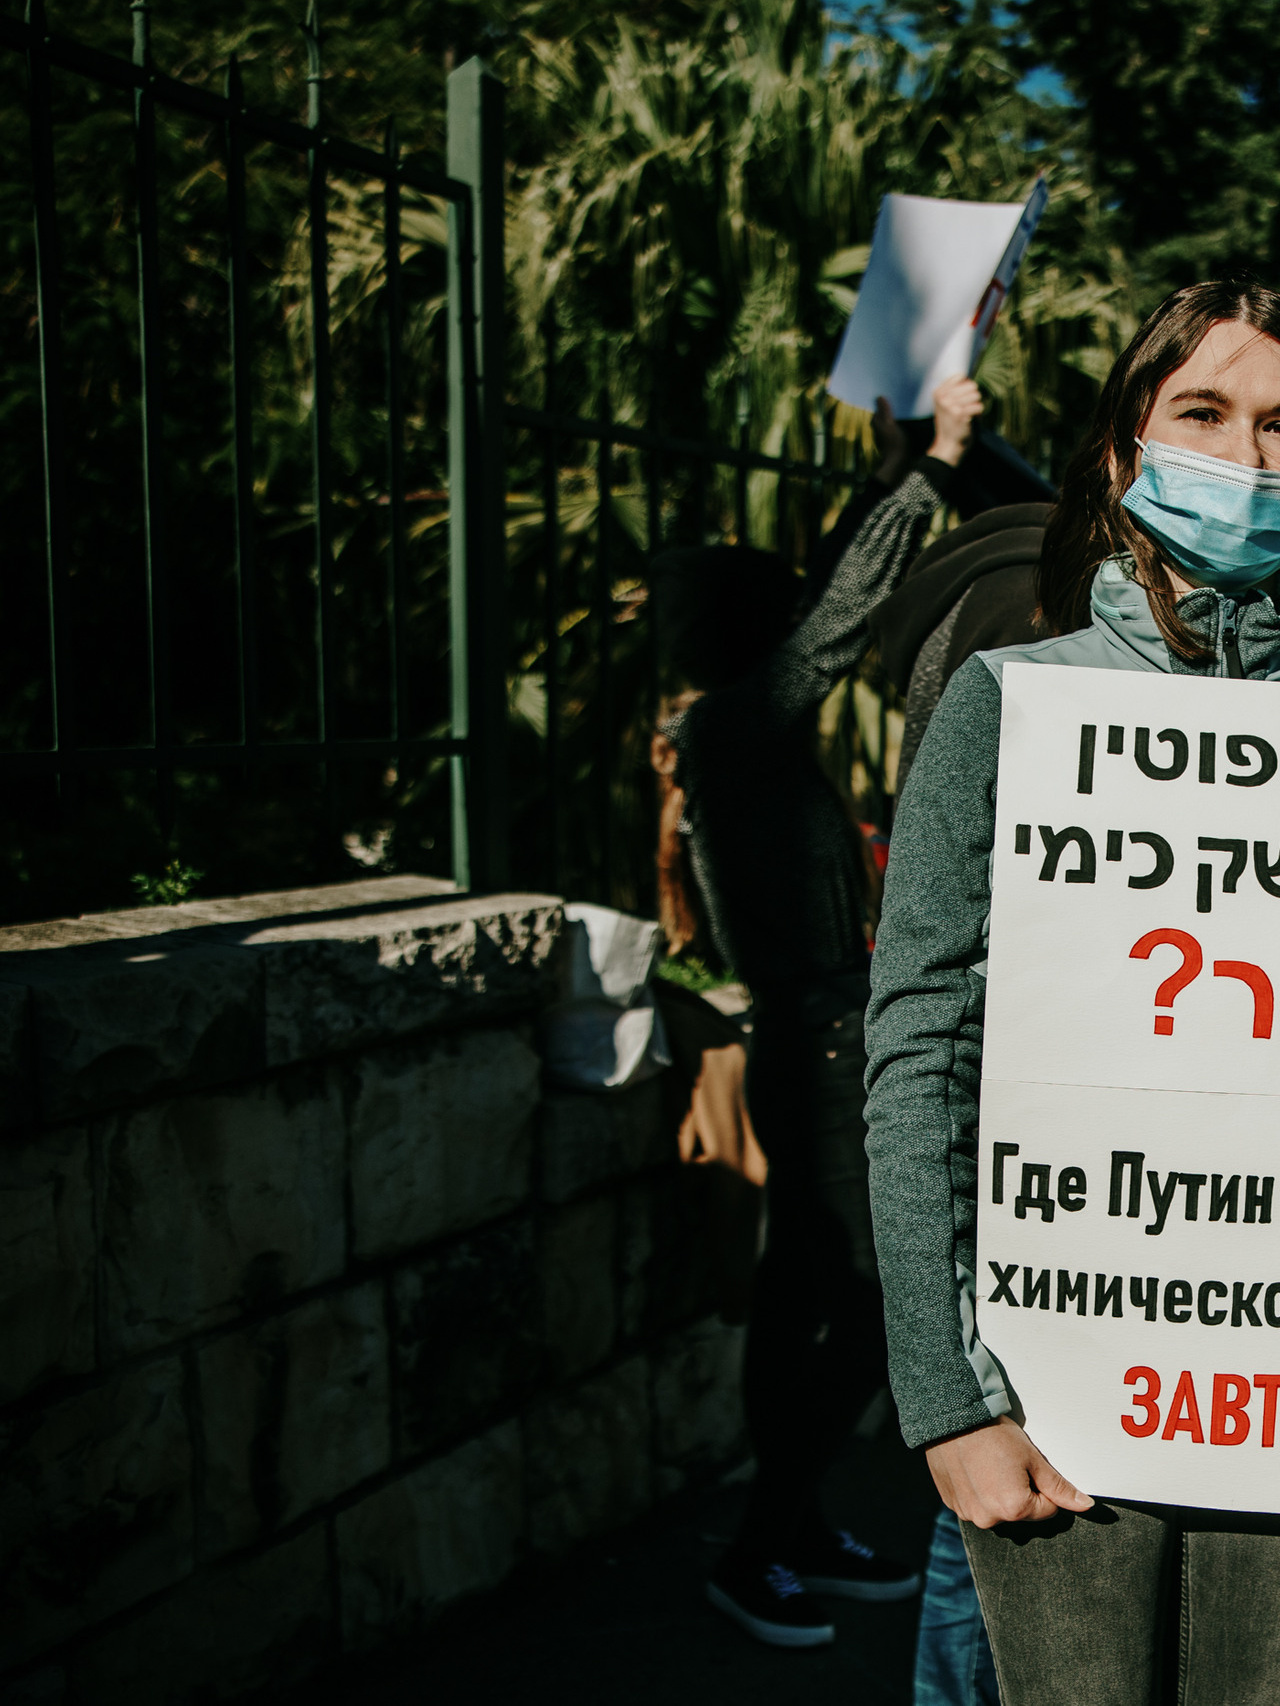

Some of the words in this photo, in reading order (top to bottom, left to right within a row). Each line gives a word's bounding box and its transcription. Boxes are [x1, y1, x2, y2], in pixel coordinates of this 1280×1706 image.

[1077, 724, 1277, 794] פוטין
[1015, 824, 1174, 889] כימי
[992, 1142, 1086, 1223] Где
[1108, 1151, 1274, 1235] Путин
